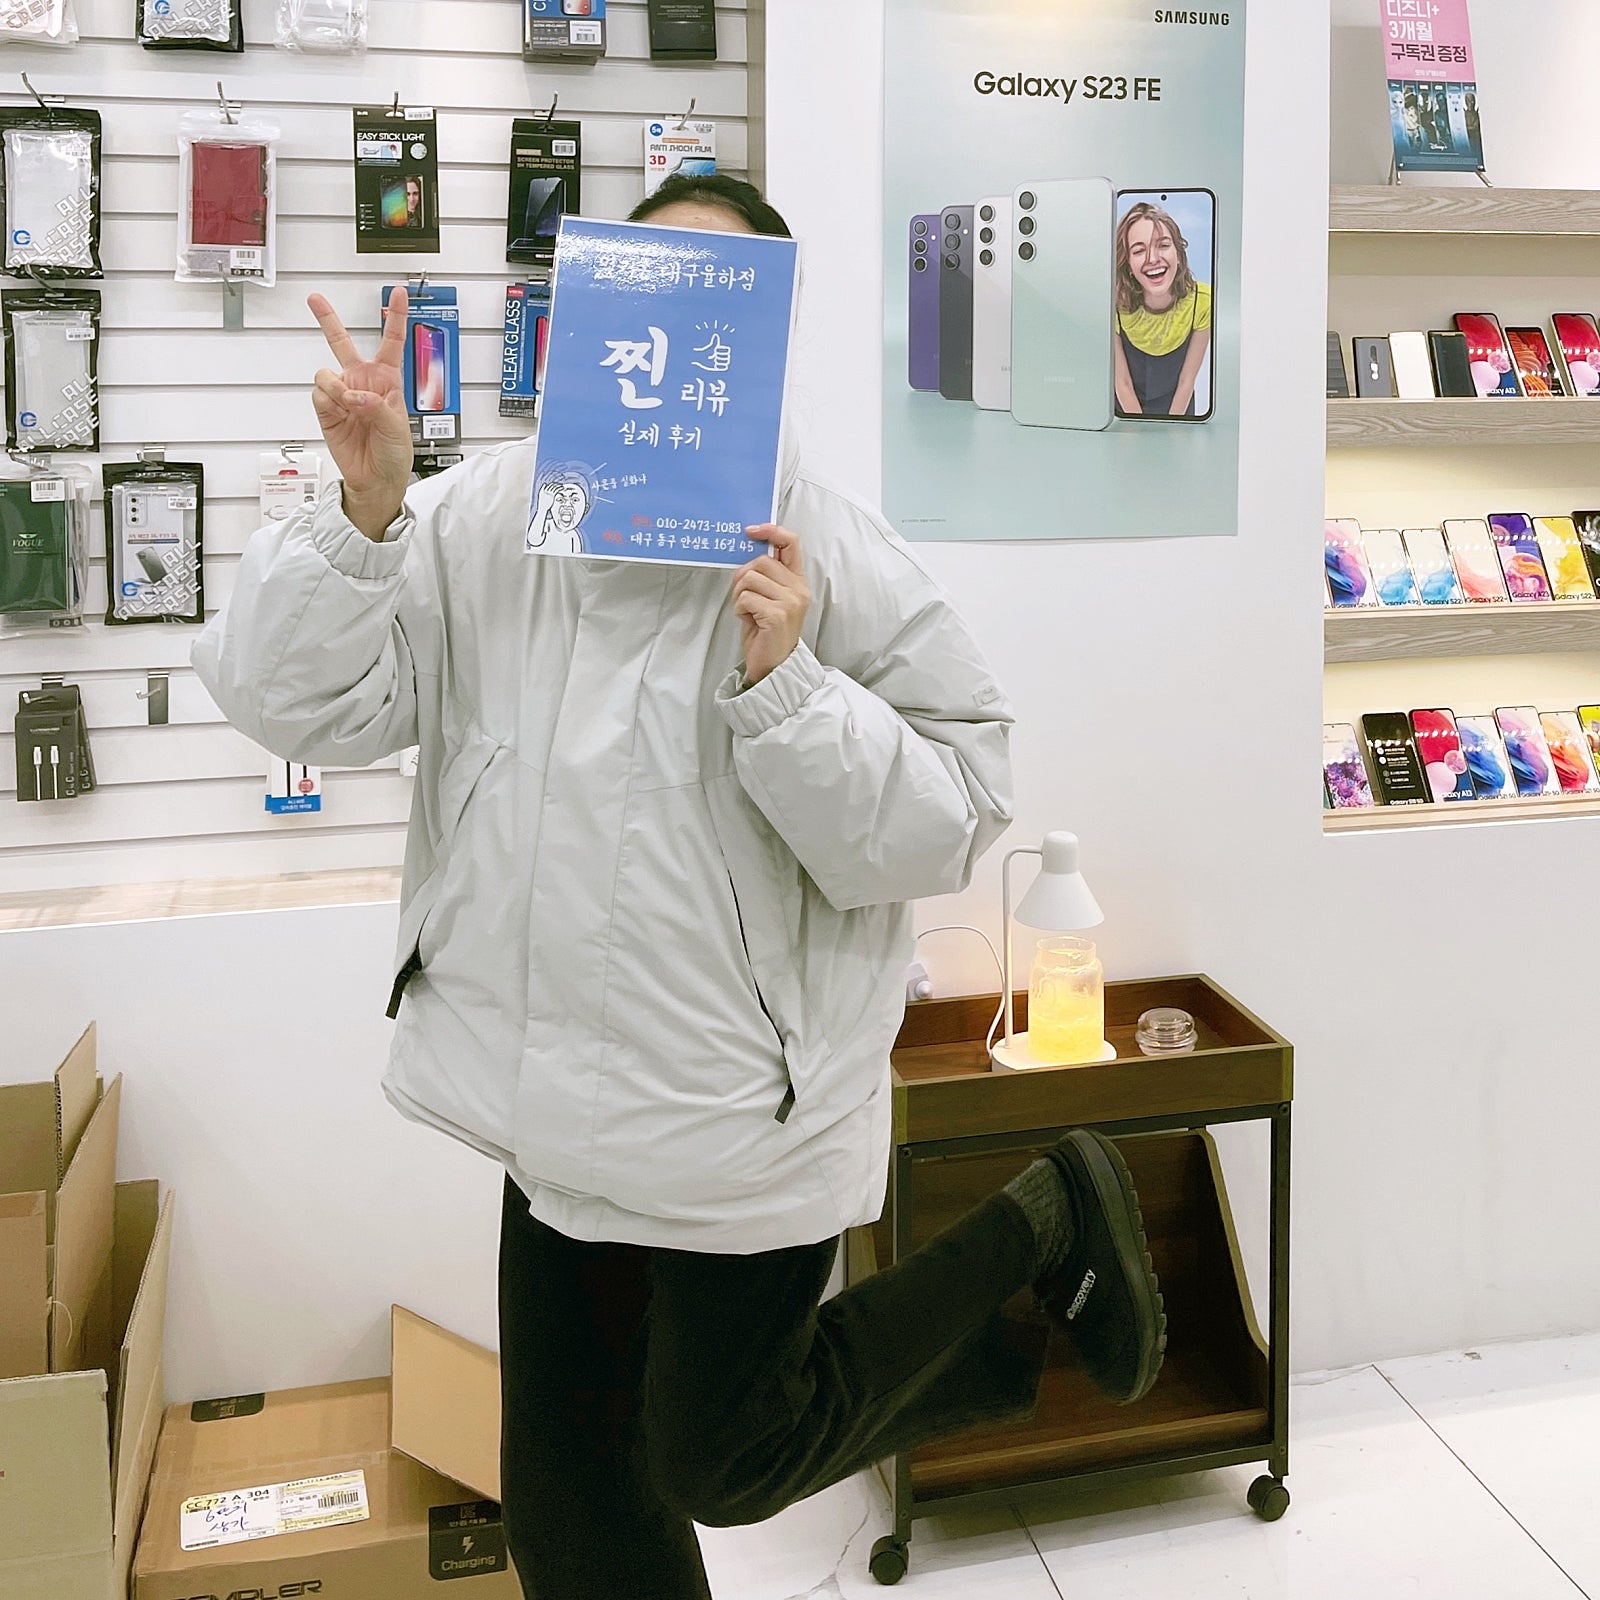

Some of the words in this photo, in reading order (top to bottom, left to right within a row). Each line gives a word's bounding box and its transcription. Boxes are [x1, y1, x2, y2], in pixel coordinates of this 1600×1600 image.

[1154, 9, 1231, 26] SAMSUNG
[1386, 0, 1440, 18] 디즈니+
[1388, 20, 1434, 42] 3개월
[1391, 42, 1436, 62] 구독권
[1437, 44, 1468, 63] 증정
[973, 71, 1078, 104] Galaxy
[1082, 75, 1128, 100] S23
[1134, 77, 1162, 102] FE
[356, 132, 378, 140] EASY
[379, 133, 401, 141] STICK
[402, 133, 426, 142] LIGHT
[649, 154, 667, 165] 3D
[55, 187, 96, 217] ALL
[504, 299, 521, 344] GLASS
[502, 345, 519, 391] CLEAR
[599, 326, 669, 409] 찐
[680, 378, 731, 417] 리뷰
[62, 372, 97, 401] ALL
[50, 389, 99, 428] CASE
[618, 419, 660, 448] 실제
[668, 423, 702, 450] 후기
[656, 517, 742, 534] 010-2473-1083
[12, 539, 45, 547] VOGUE
[162, 539, 202, 567] ALL
[630, 531, 653, 547] 대구
[657, 533, 676, 549] 동구
[680, 535, 710, 550] 안심로
[713, 538, 736, 552] 16길
[739, 540, 754, 553] 45
[1461, 789, 1474, 797] A13
[206, 1497, 227, 1507] 772
[247, 1489, 270, 1499] 304
[441, 1555, 497, 1572] Charging
